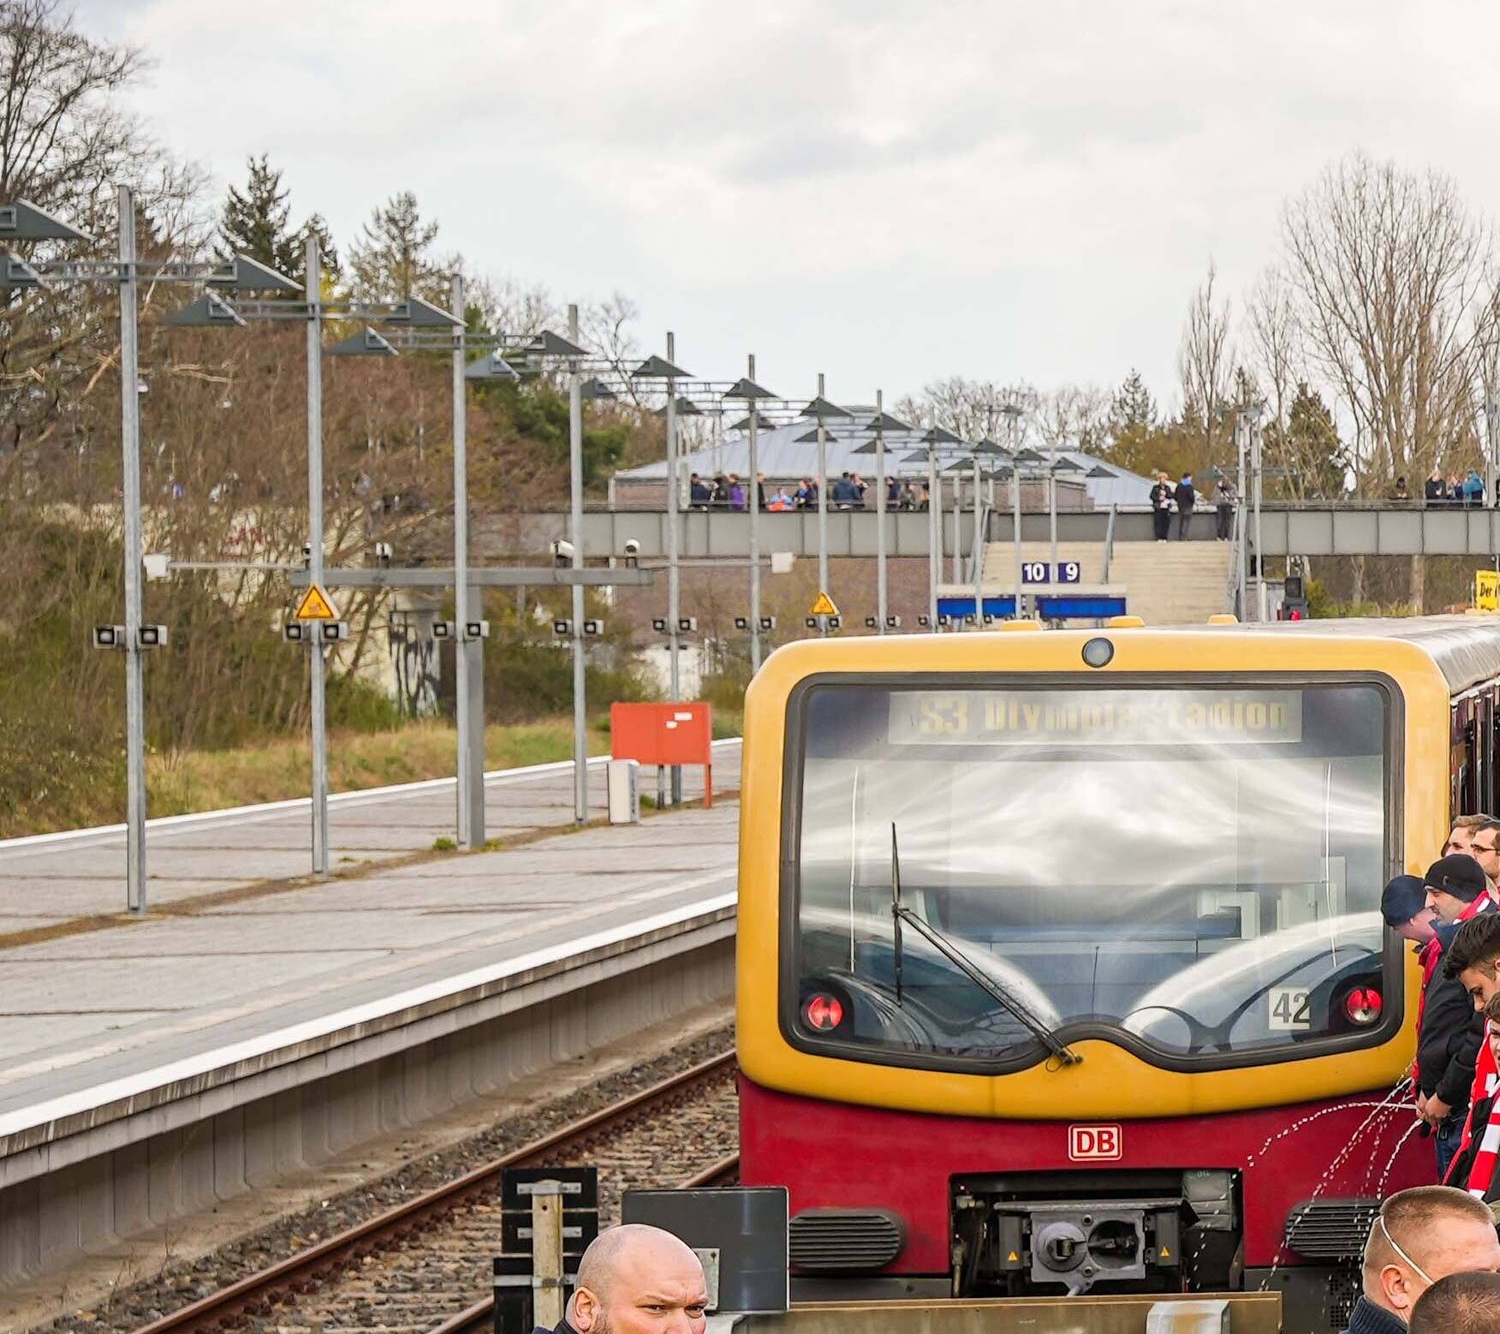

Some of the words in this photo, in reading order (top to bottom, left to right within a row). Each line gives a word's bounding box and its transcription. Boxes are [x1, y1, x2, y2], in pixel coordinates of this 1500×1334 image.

[1024, 563, 1044, 581] 10
[1066, 563, 1078, 581] 9
[1272, 992, 1312, 1024] 42
[1074, 1128, 1118, 1157] DB
